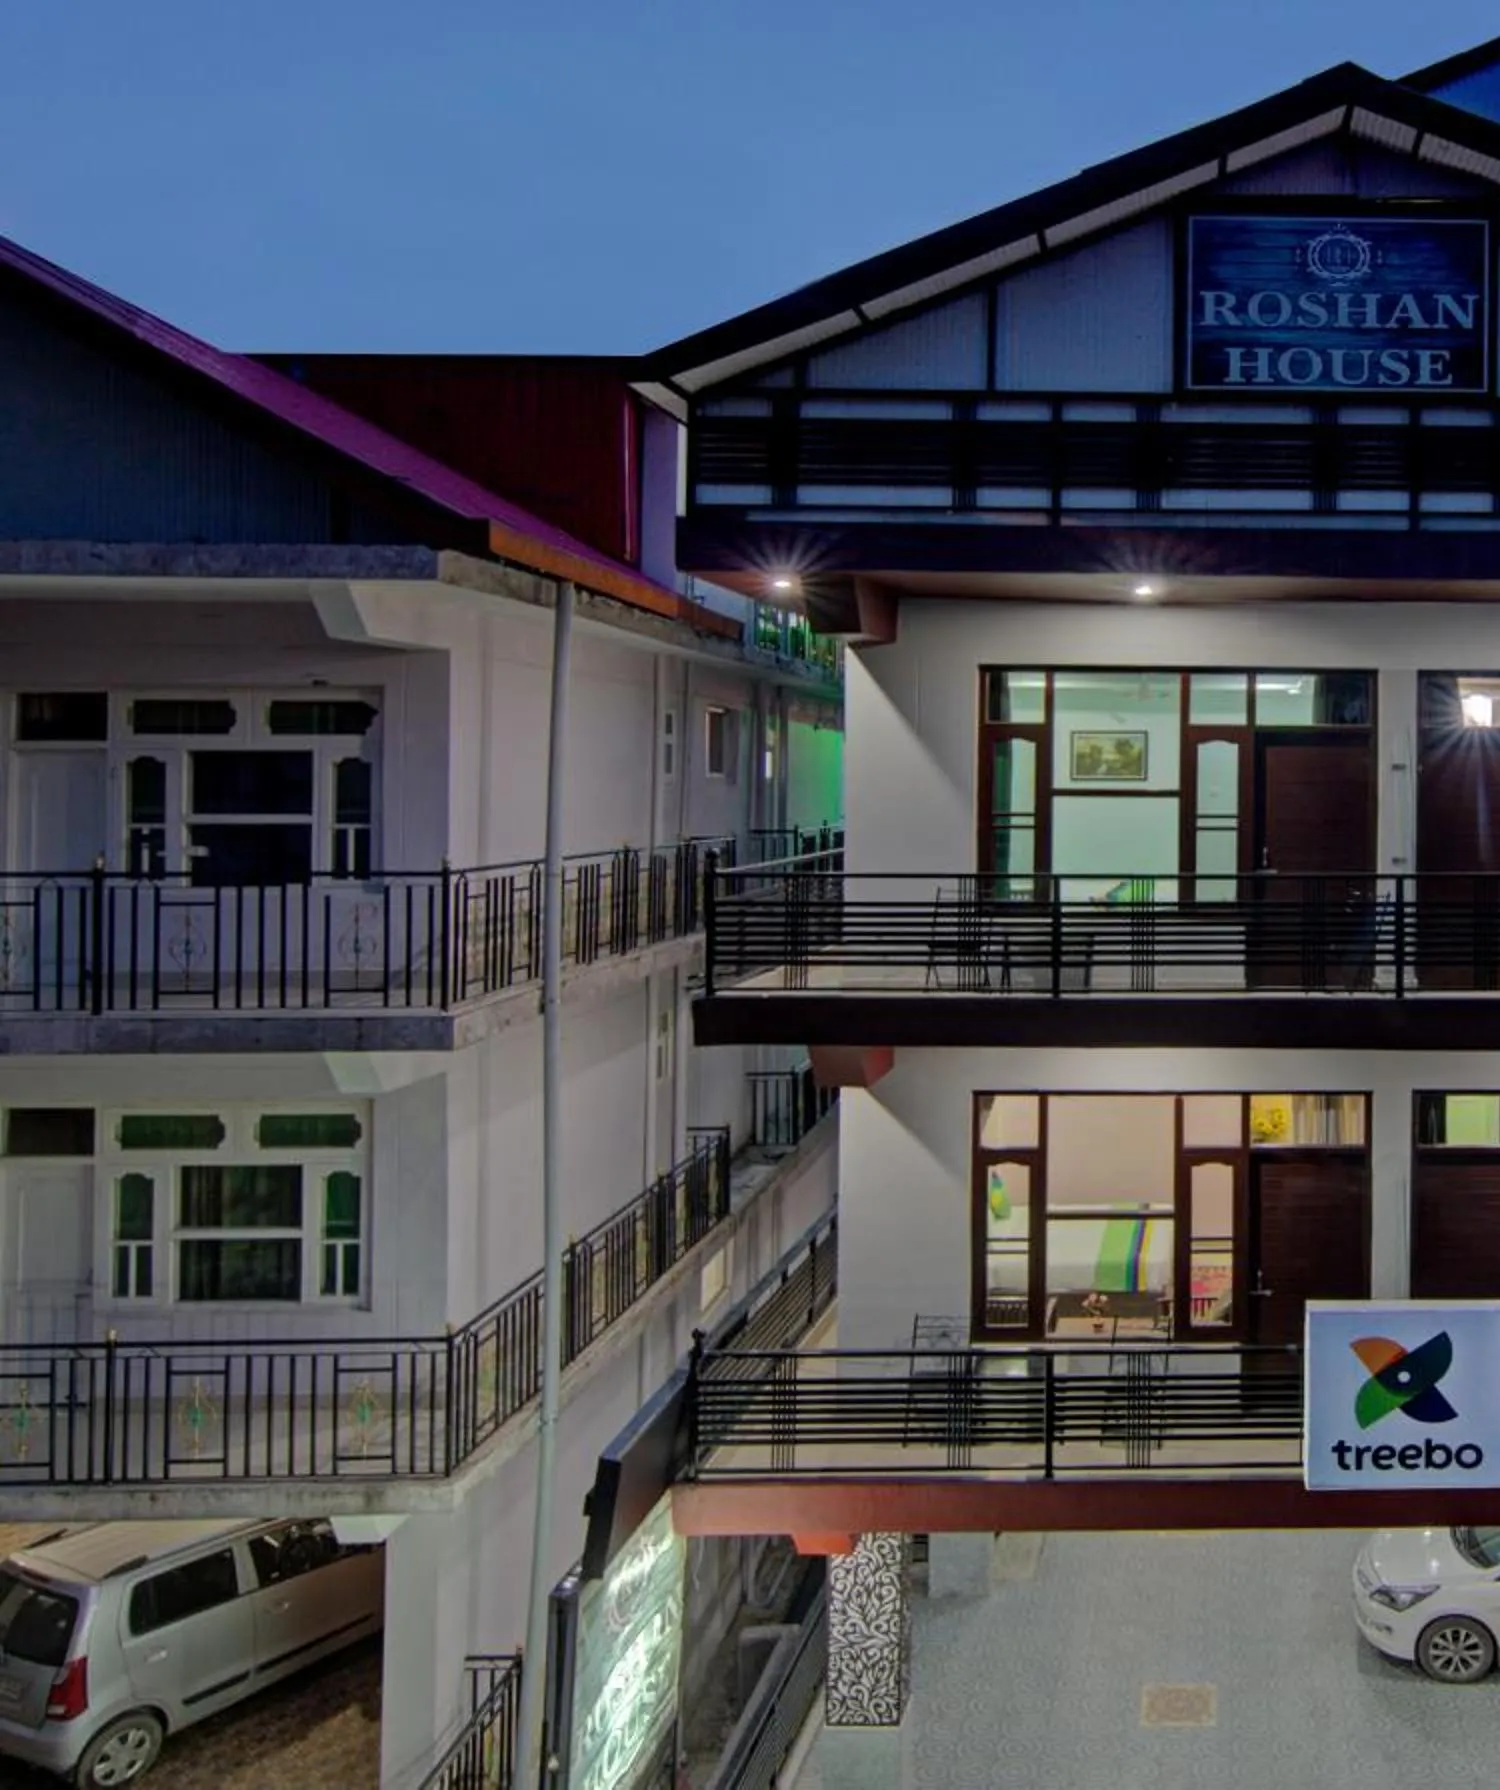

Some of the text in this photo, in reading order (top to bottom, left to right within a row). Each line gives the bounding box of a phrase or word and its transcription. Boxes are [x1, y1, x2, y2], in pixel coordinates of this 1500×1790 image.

[1200, 291, 1480, 329] ROSHAN
[1223, 347, 1453, 385] HOUSE
[1331, 1437, 1483, 1471] treebo
